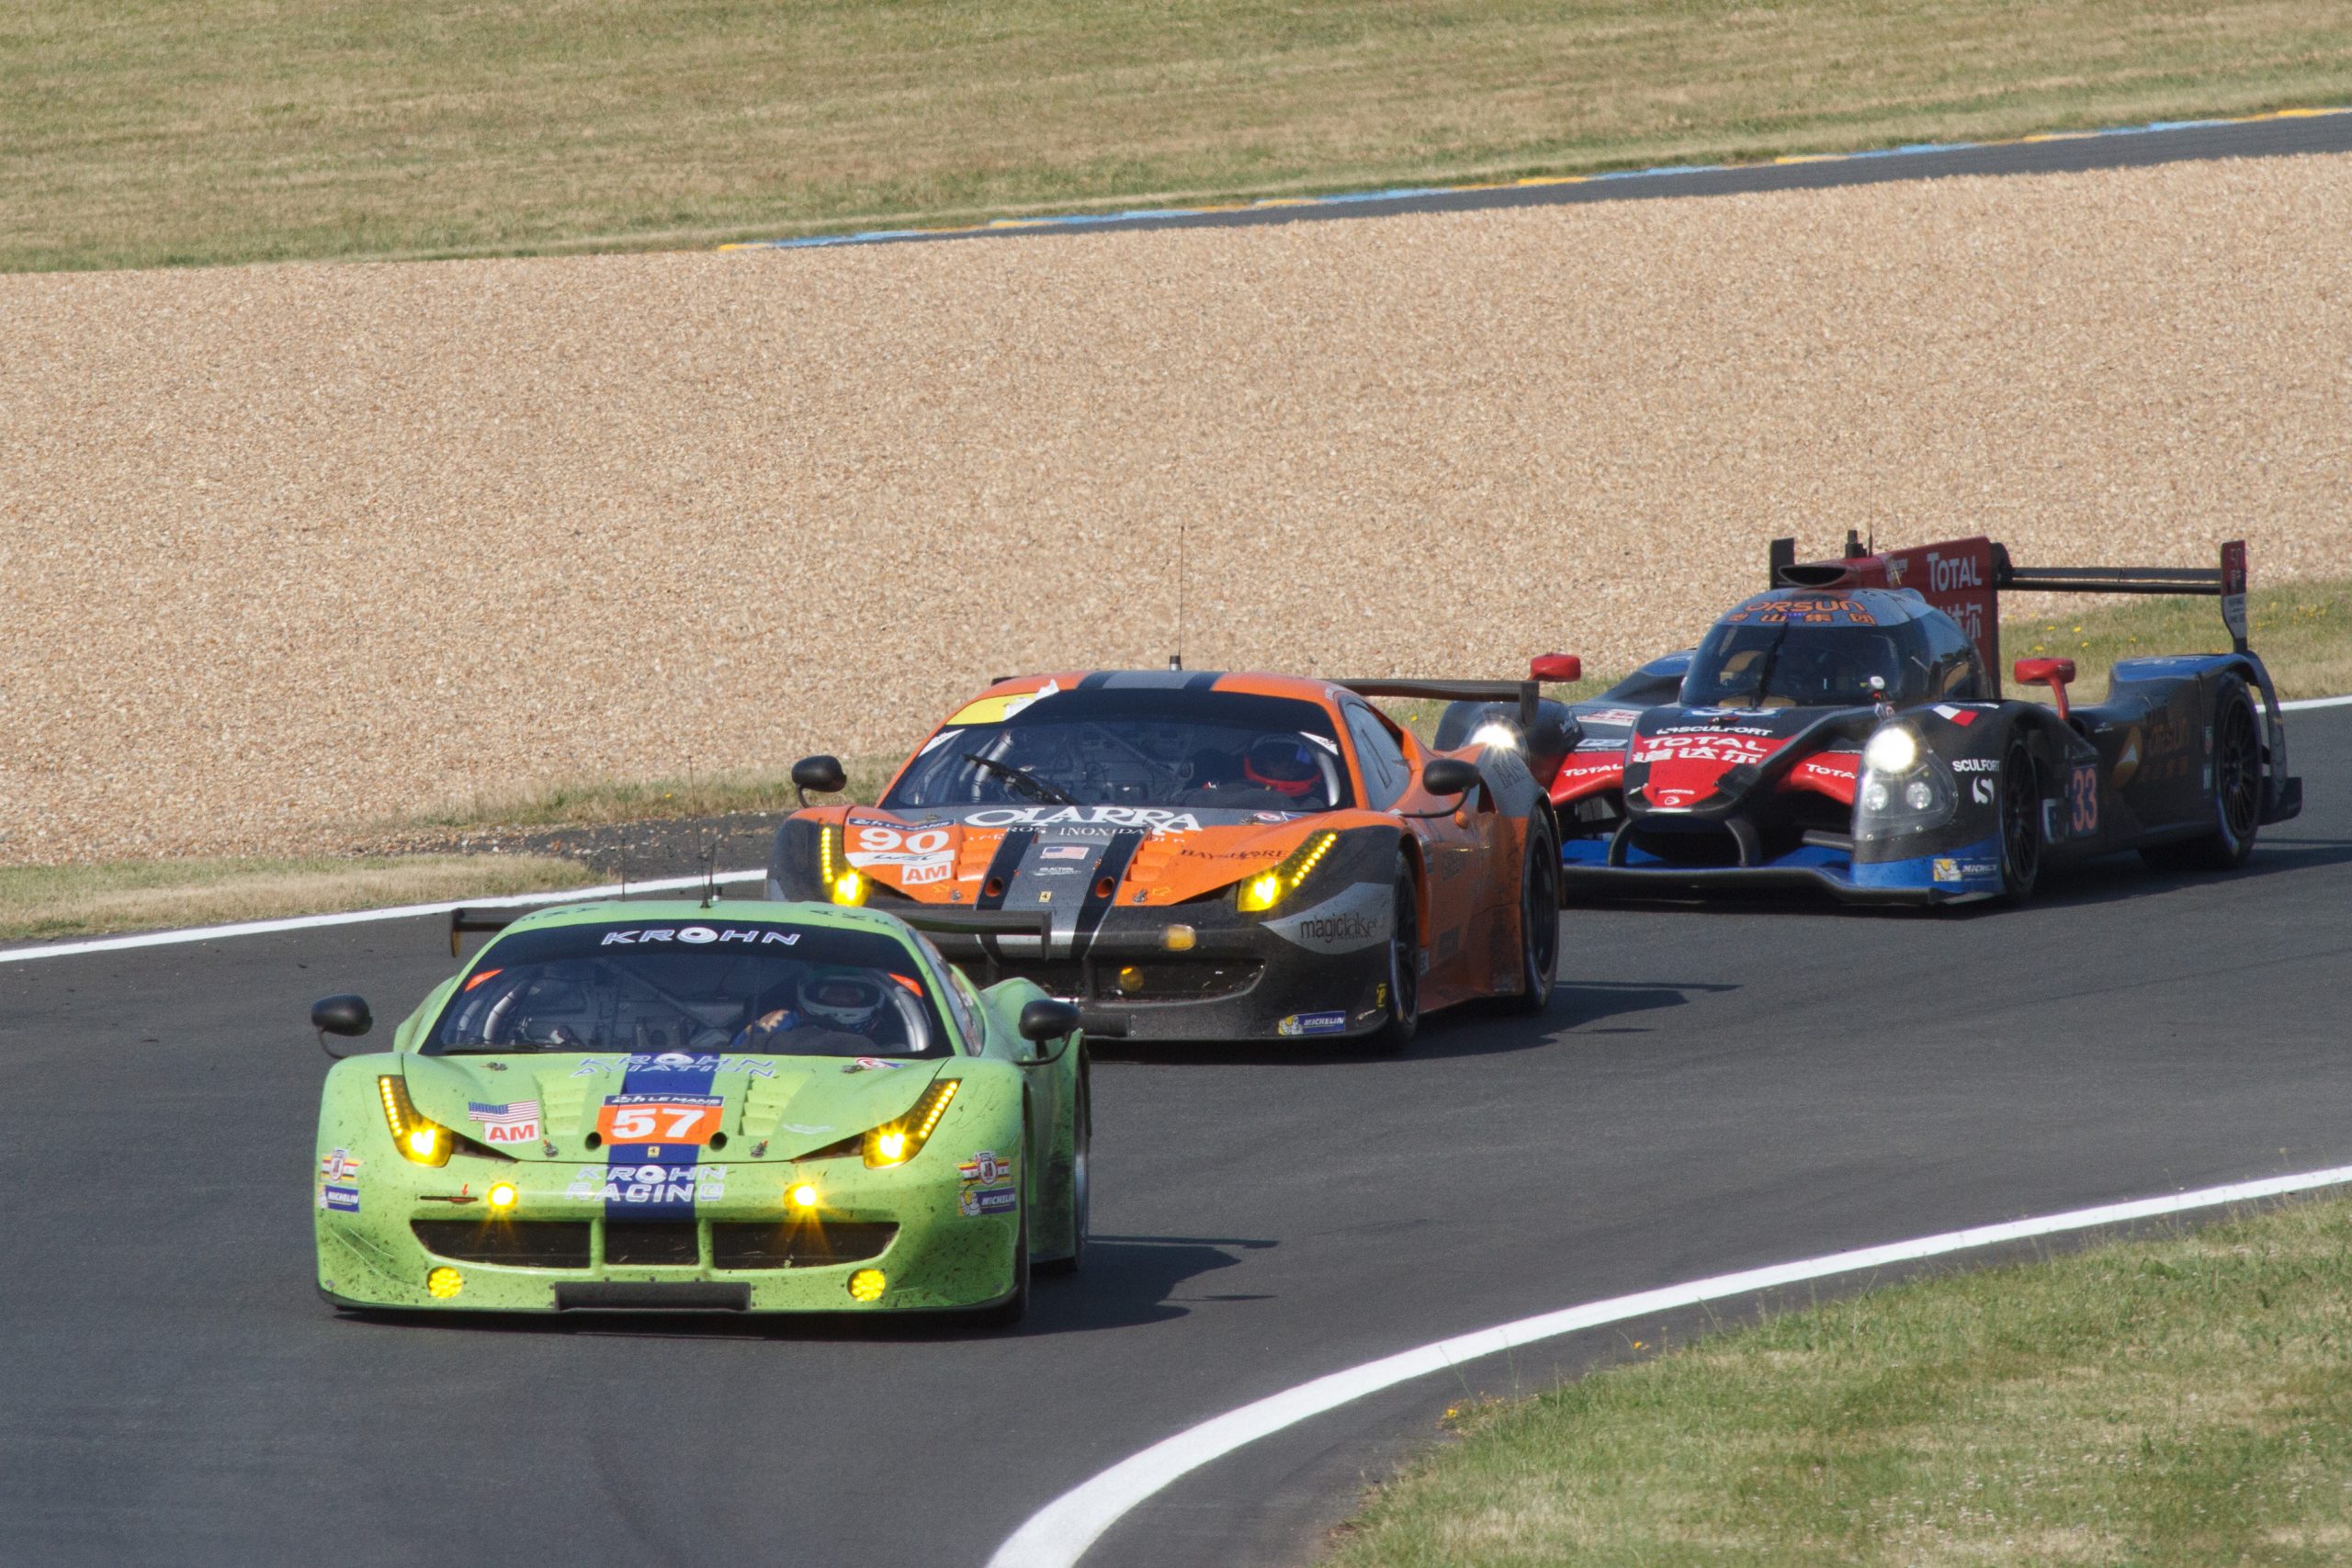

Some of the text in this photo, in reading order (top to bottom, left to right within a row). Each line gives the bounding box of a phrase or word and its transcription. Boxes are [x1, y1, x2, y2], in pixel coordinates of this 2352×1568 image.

[1927, 552, 1982, 592] TOTAL
[1644, 736, 1768, 752] TOTAL
[1564, 763, 1623, 776] TOTAL
[1805, 763, 1856, 779] TOTA
[1952, 759, 2000, 772] SCULFORT
[2072, 769, 2098, 831] 33
[859, 828, 949, 854] 90
[906, 865, 947, 881] AM
[601, 927, 801, 945] KROHN
[1300, 912, 1376, 943] magiclake
[1305, 1017, 1345, 1026] MICHELIN
[578, 1053, 775, 1067] KROHN
[611, 1108, 706, 1138] 57
[489, 1124, 535, 1142] AM
[575, 1165, 728, 1185] KROHN
[564, 1182, 725, 1203] RACING
[981, 1194, 1015, 1205] MICHELIN
